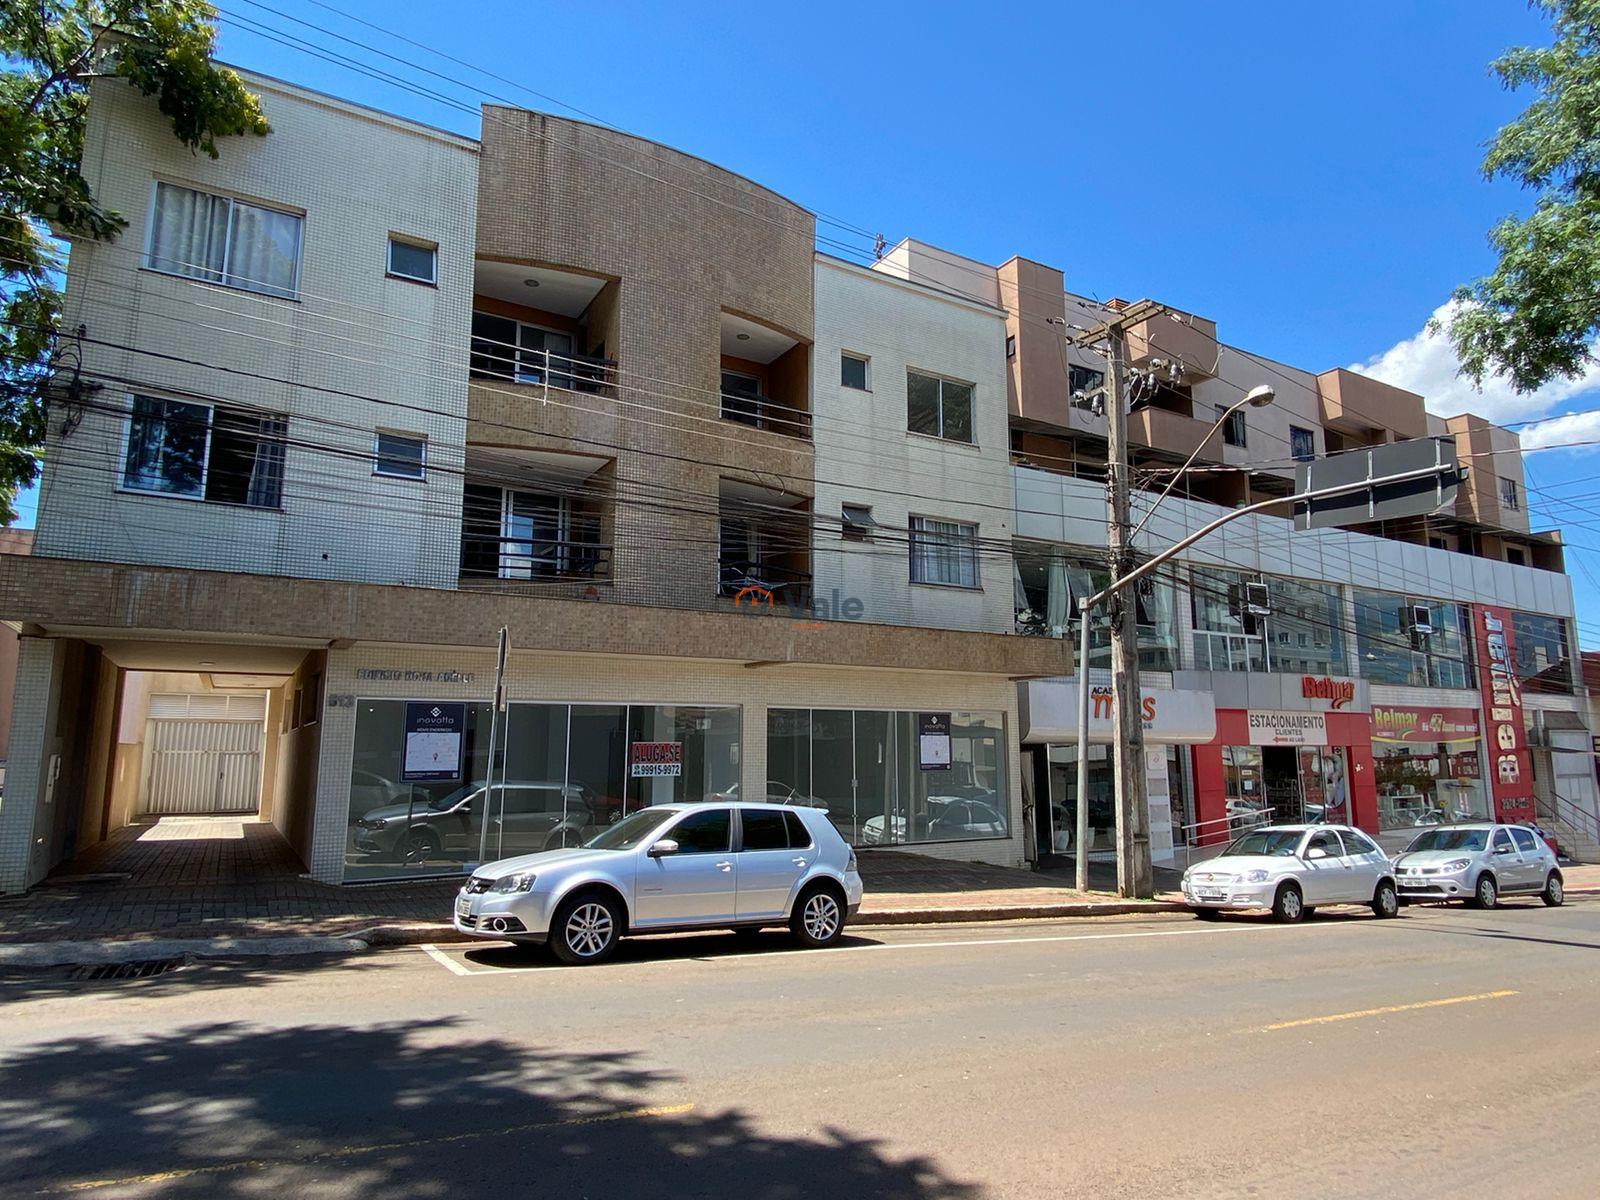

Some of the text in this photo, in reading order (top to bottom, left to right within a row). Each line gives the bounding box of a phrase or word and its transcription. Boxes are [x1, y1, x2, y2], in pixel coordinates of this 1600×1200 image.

[1249, 714, 1324, 728] ESTACIONAMENTO
[1374, 708, 1418, 727] Belmar
[634, 744, 681, 762] ALUGA-SE
